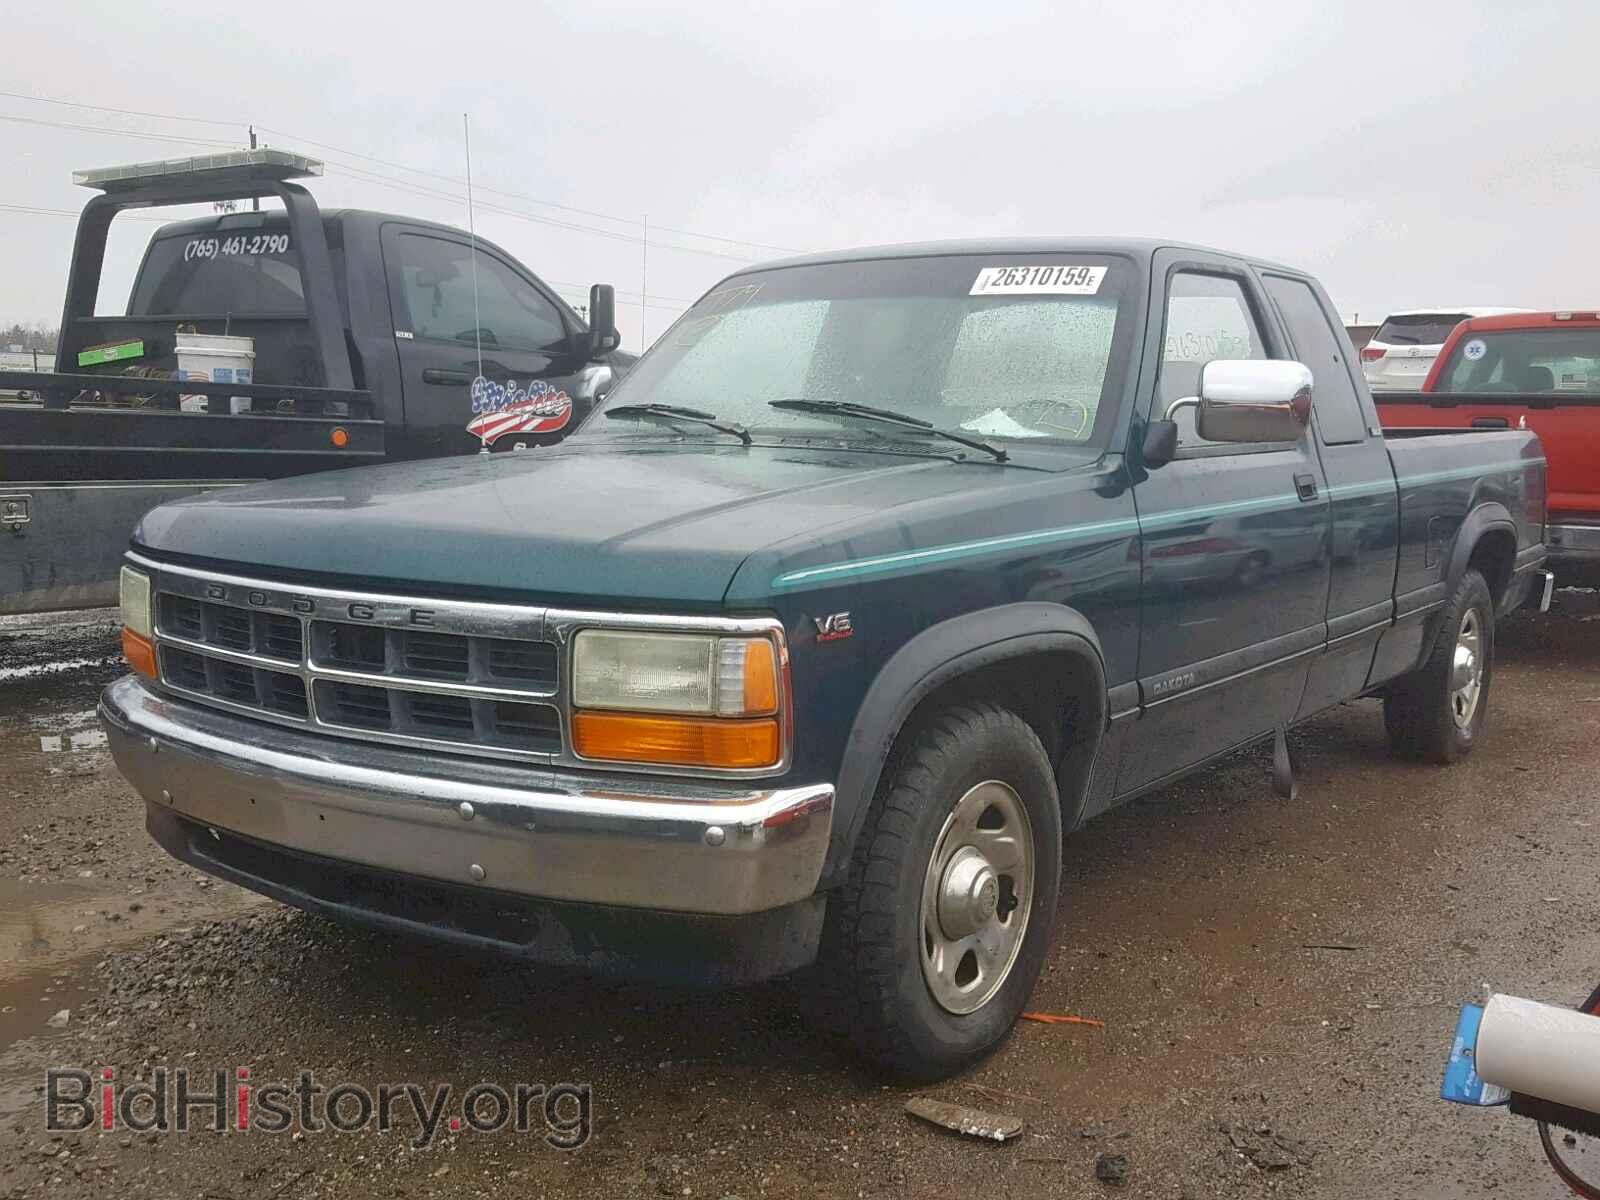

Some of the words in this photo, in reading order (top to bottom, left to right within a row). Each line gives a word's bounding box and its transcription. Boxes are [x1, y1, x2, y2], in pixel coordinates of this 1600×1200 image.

[184, 238, 219, 262] (765)
[222, 234, 289, 255] 461-2790
[207, 583, 436, 627] DODGE
[814, 611, 851, 634] V6
[1152, 672, 1195, 697] DAKOTA
